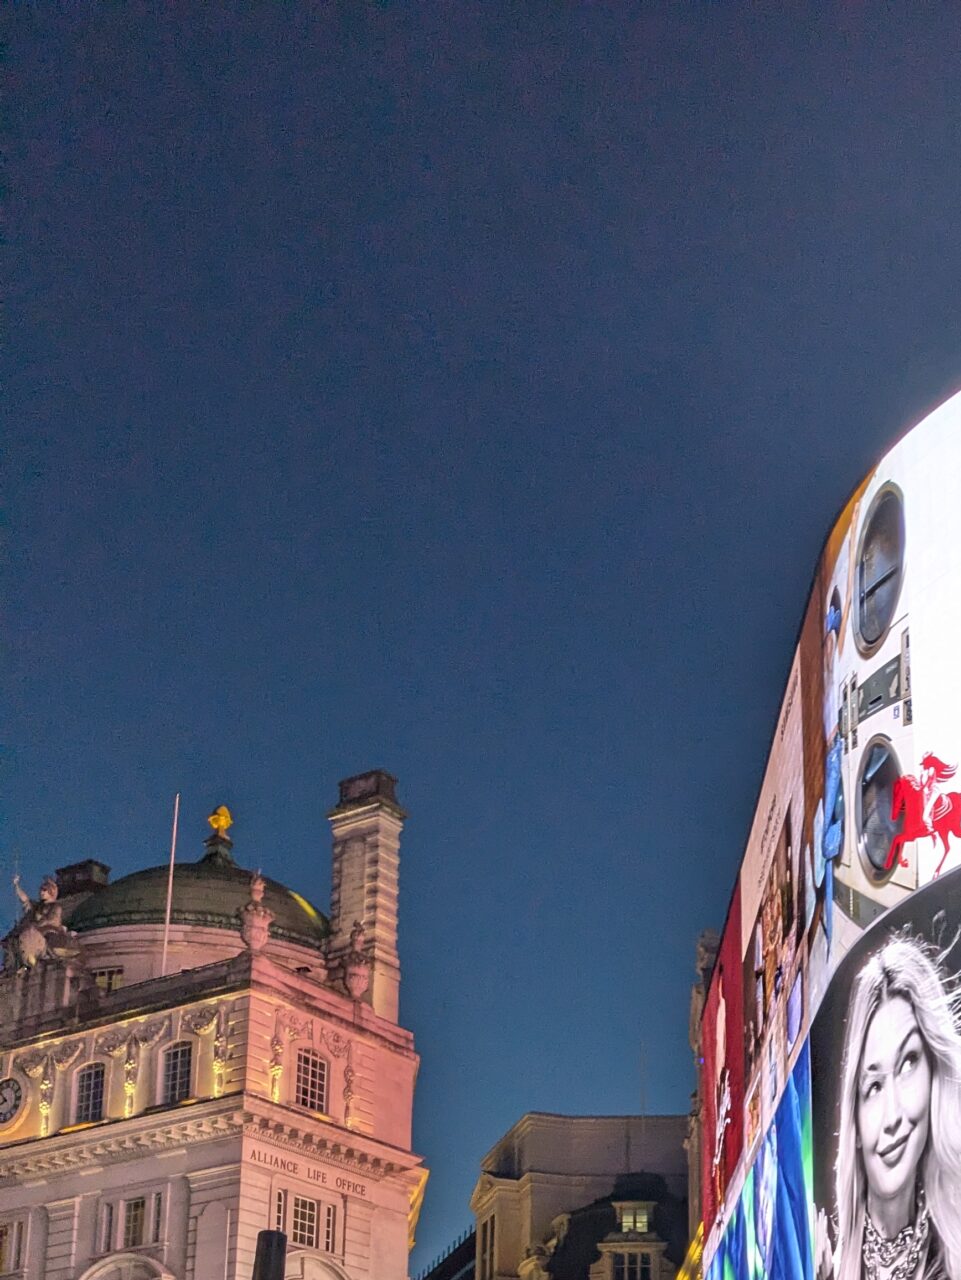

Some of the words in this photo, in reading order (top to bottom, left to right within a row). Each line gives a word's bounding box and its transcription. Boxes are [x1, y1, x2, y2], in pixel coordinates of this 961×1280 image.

[250, 1149, 299, 1174] ALLIANCE
[307, 1167, 327, 1183] LIFE
[335, 1176, 366, 1196] OFFICE
